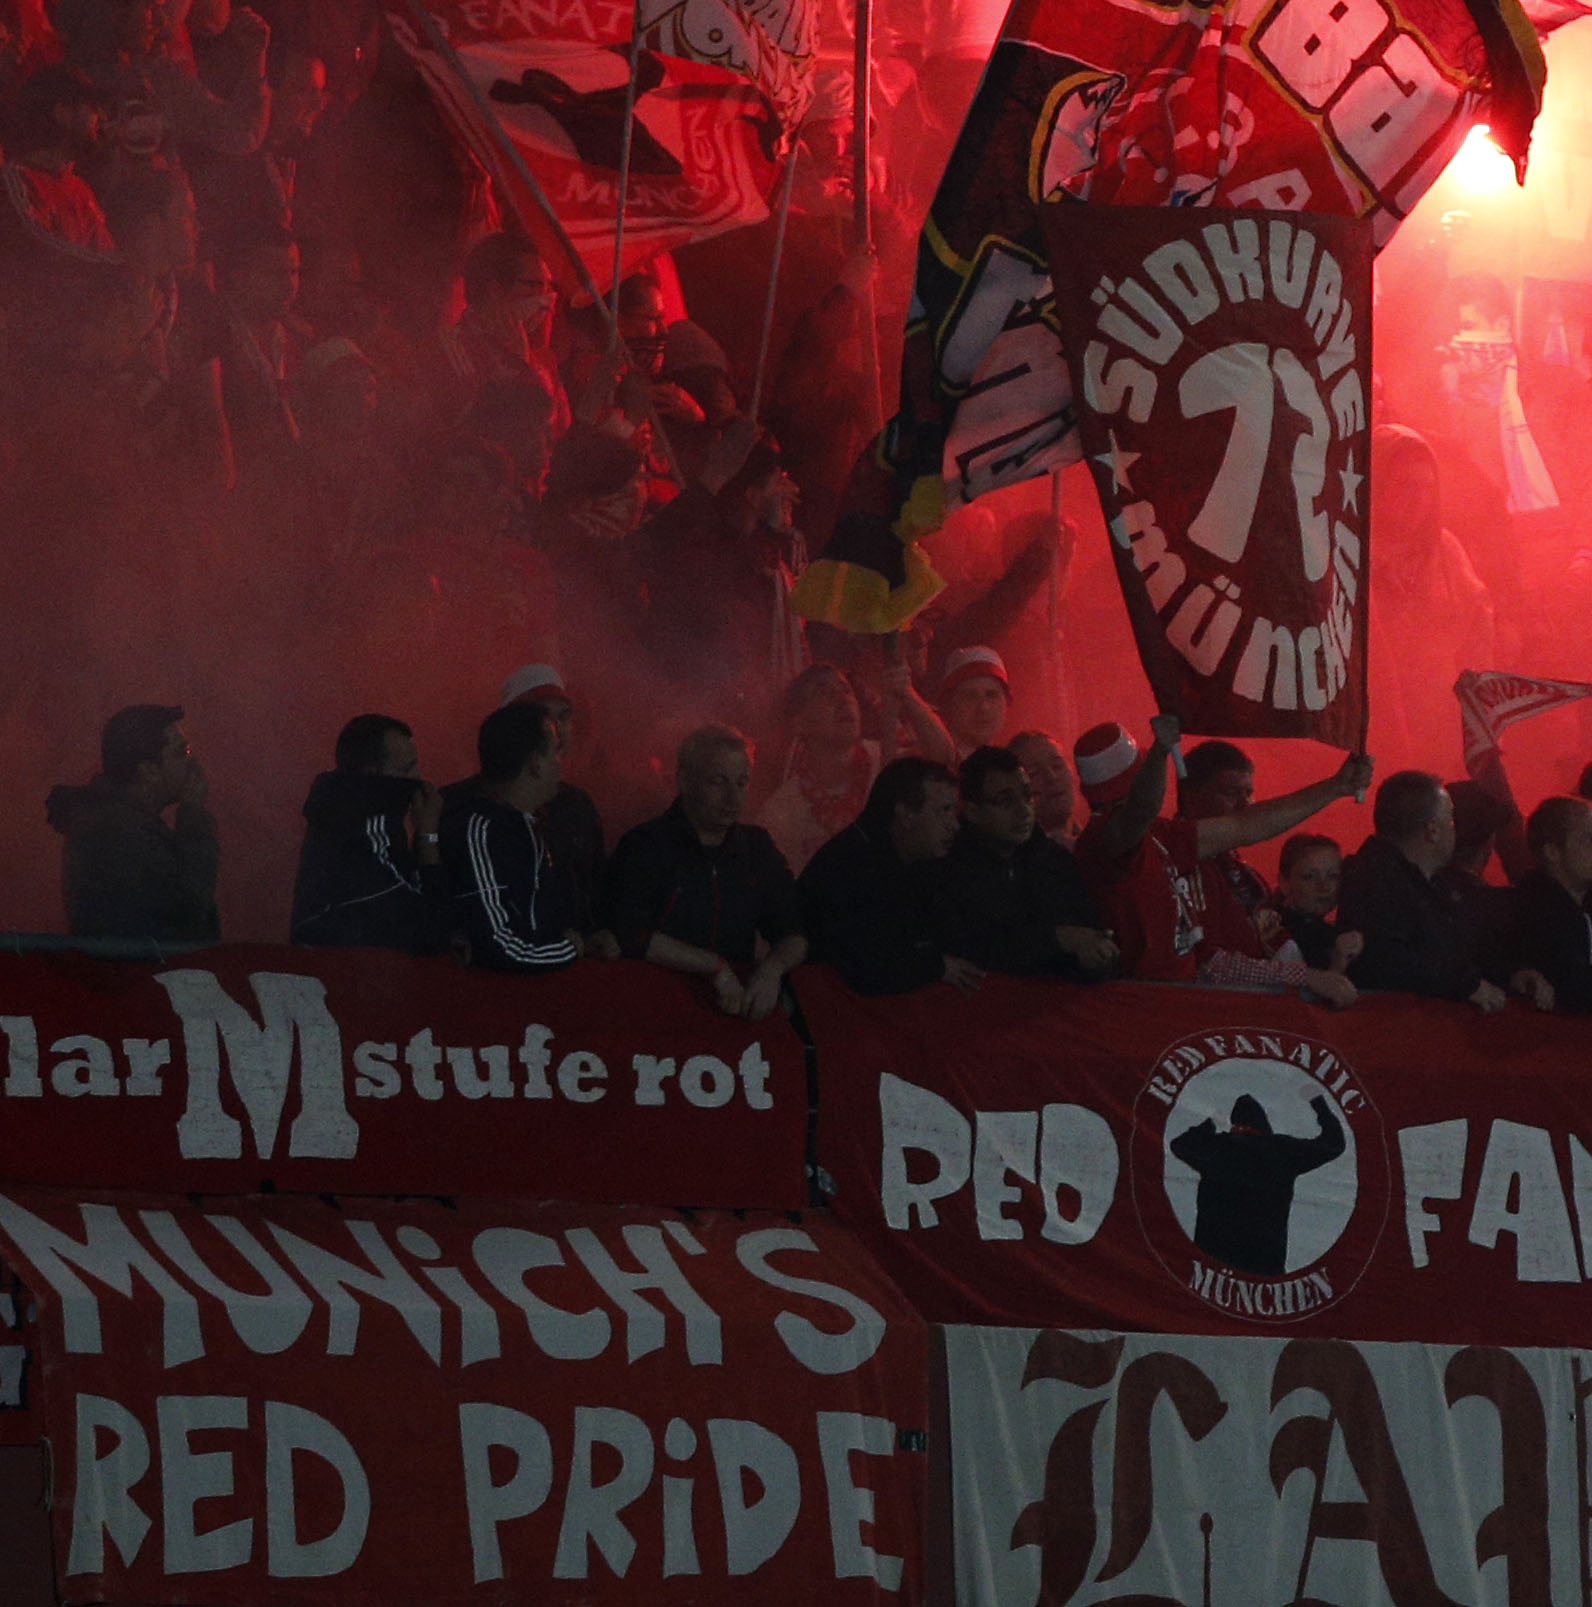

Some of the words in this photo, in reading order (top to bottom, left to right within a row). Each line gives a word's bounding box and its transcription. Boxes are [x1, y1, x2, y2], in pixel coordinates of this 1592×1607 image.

[1083, 216, 1367, 442] SÜDKURVE
[1177, 341, 1332, 584] 72
[632, 1040, 774, 1110] rot
[878, 1070, 1119, 1246] RED
[1147, 1043, 1206, 1107] RED
[1203, 1033, 1367, 1115] FANATIC
[1187, 1259, 1335, 1316] MÜNCHEN
[67, 1393, 372, 1580] RED
